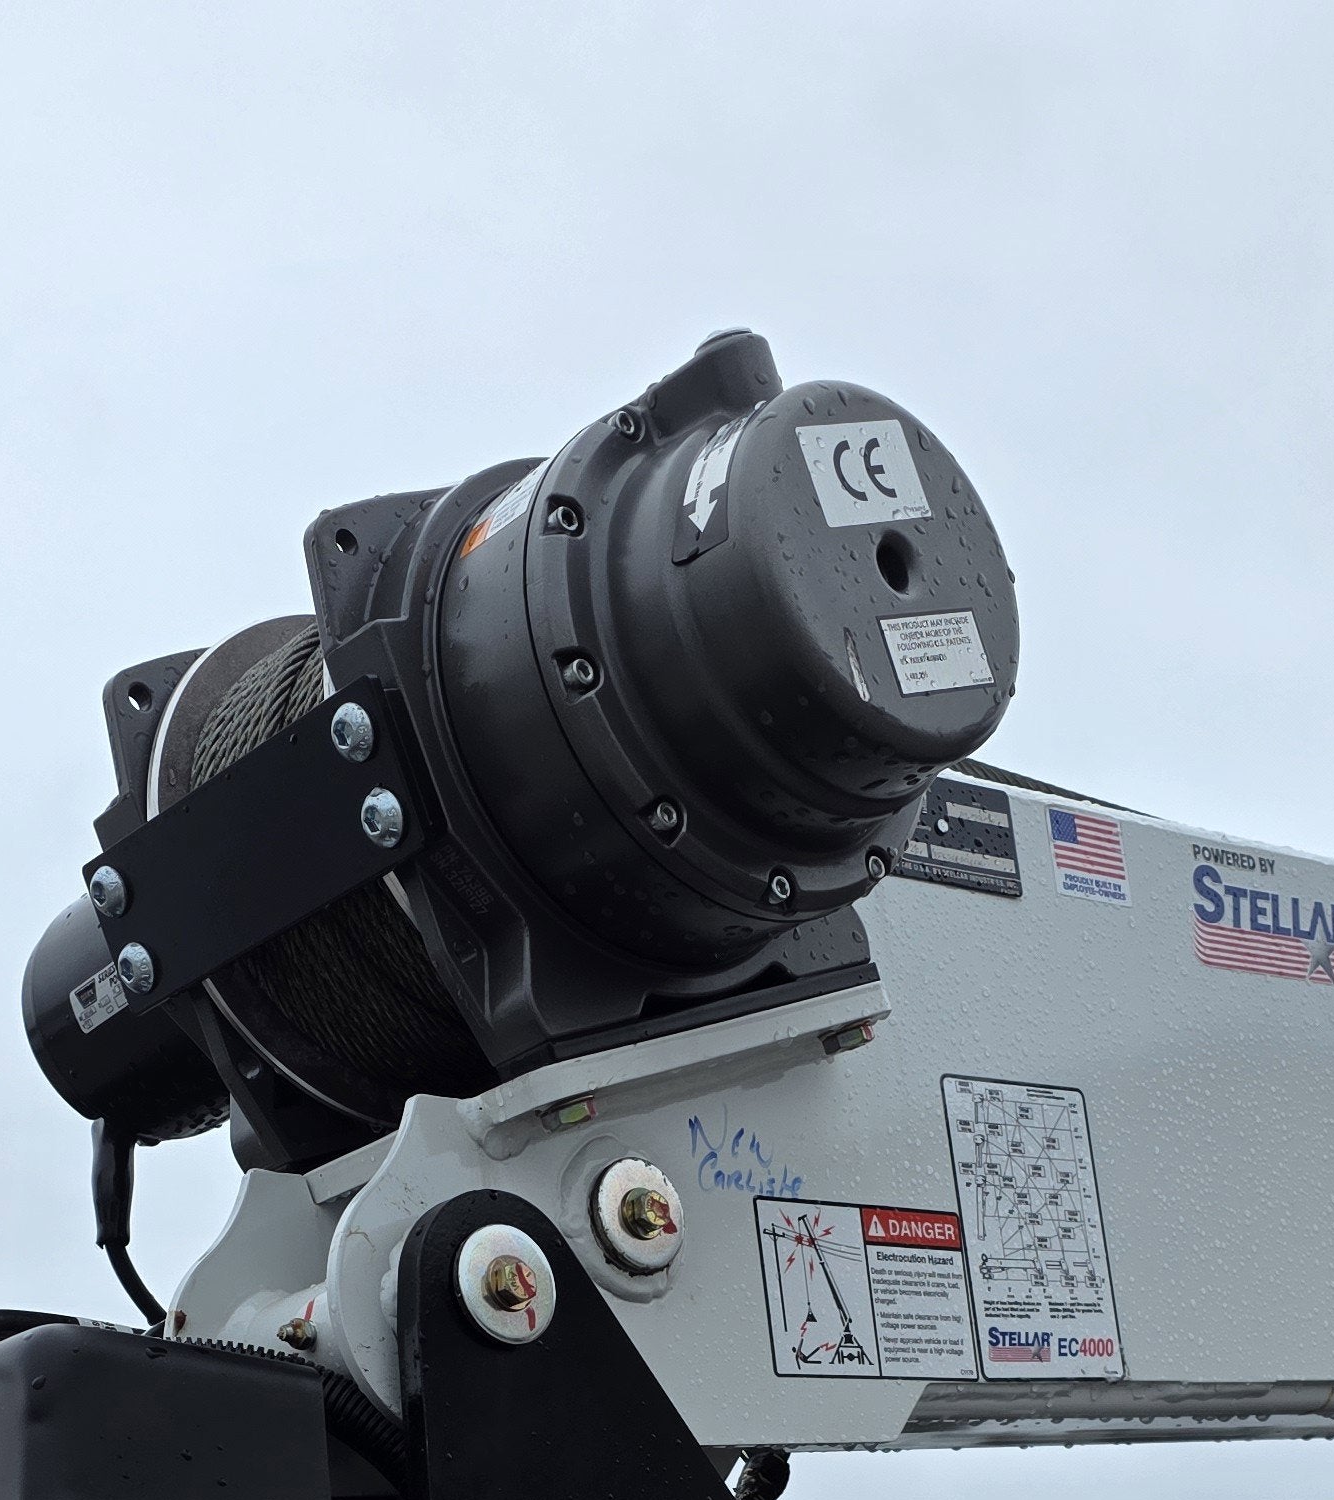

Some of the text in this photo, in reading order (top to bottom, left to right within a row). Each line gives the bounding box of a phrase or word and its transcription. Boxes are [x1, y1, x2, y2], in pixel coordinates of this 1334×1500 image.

[833, 437, 898, 501] CE
[902, 620, 929, 631] PRODUCT
[953, 626, 964, 635] THE
[897, 640, 934, 651] FOLLOWING
[1192, 843, 1275, 875] POWERED BY
[1064, 873, 1093, 887] PROUDLY
[1112, 882, 1122, 892] BY
[888, 1218, 955, 1241] DANGER
[876, 1251, 954, 1265] Electrocution Hazard
[988, 1326, 1114, 1357] STELLAR EC4000
